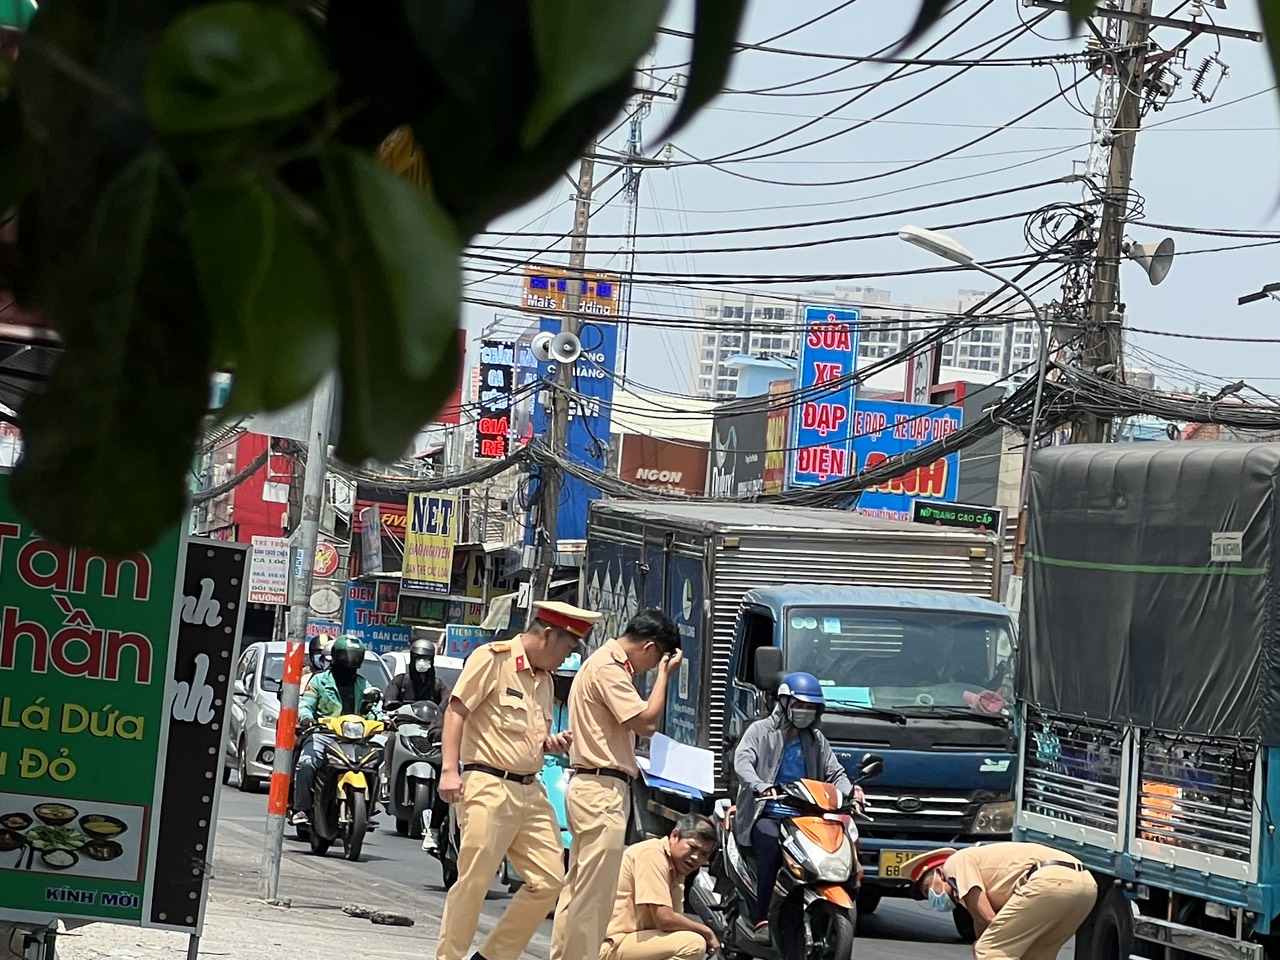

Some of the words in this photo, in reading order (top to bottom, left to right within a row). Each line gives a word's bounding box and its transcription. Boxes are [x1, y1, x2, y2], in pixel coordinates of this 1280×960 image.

[807, 313, 852, 351] SỬA
[812, 362, 842, 391] XE
[479, 416, 508, 435] GIÁ
[802, 401, 847, 436] ĐẠP
[865, 412, 886, 441] ĐẠP
[893, 414, 909, 439] XE
[636, 468, 682, 483] NGON
[797, 444, 846, 482] ĐIỆN
[411, 496, 454, 537] NET
[957, 513, 975, 522] CAO
[1, 697, 50, 731] Lá
[61, 704, 145, 740] Dứa
[19, 747, 77, 782] Đỏ
[45, 886, 95, 905] KÍNH
[101, 890, 140, 909] MỜI
